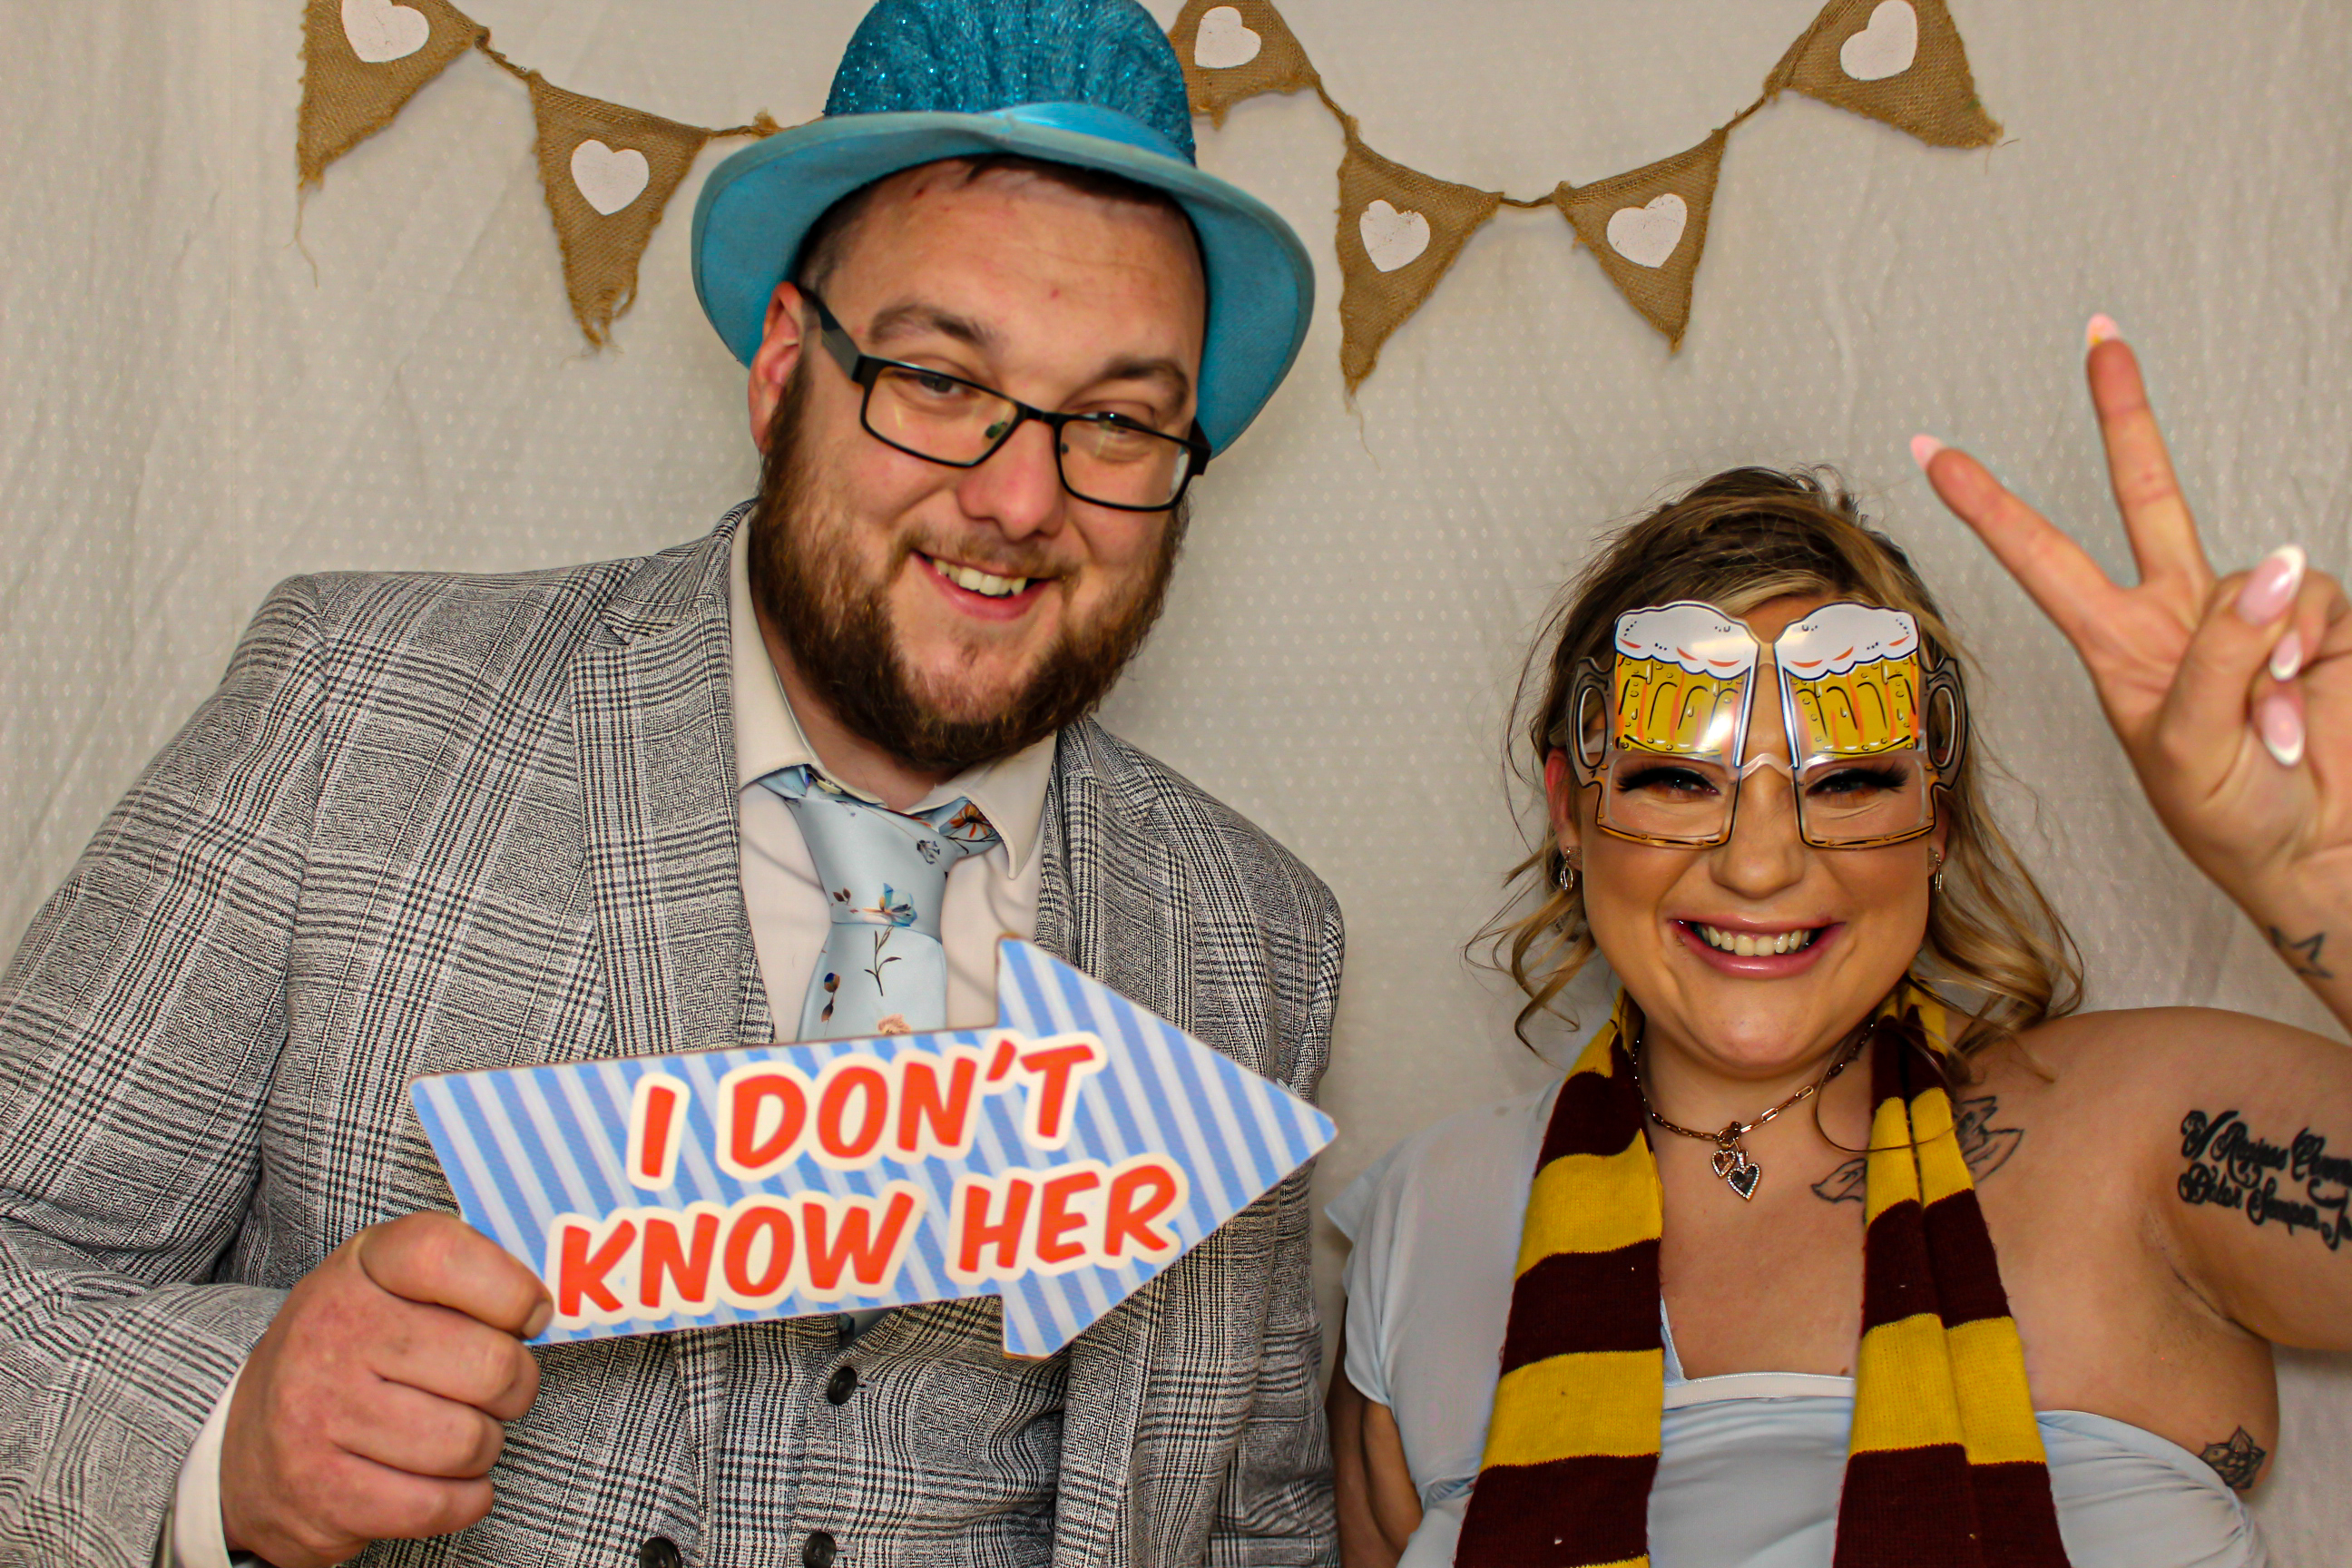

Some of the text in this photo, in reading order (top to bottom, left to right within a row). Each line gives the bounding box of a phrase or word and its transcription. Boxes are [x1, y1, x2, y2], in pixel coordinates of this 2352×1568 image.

[641, 1039, 1094, 1179] I DON'T
[557, 1164, 1179, 1318] KNOW HER
